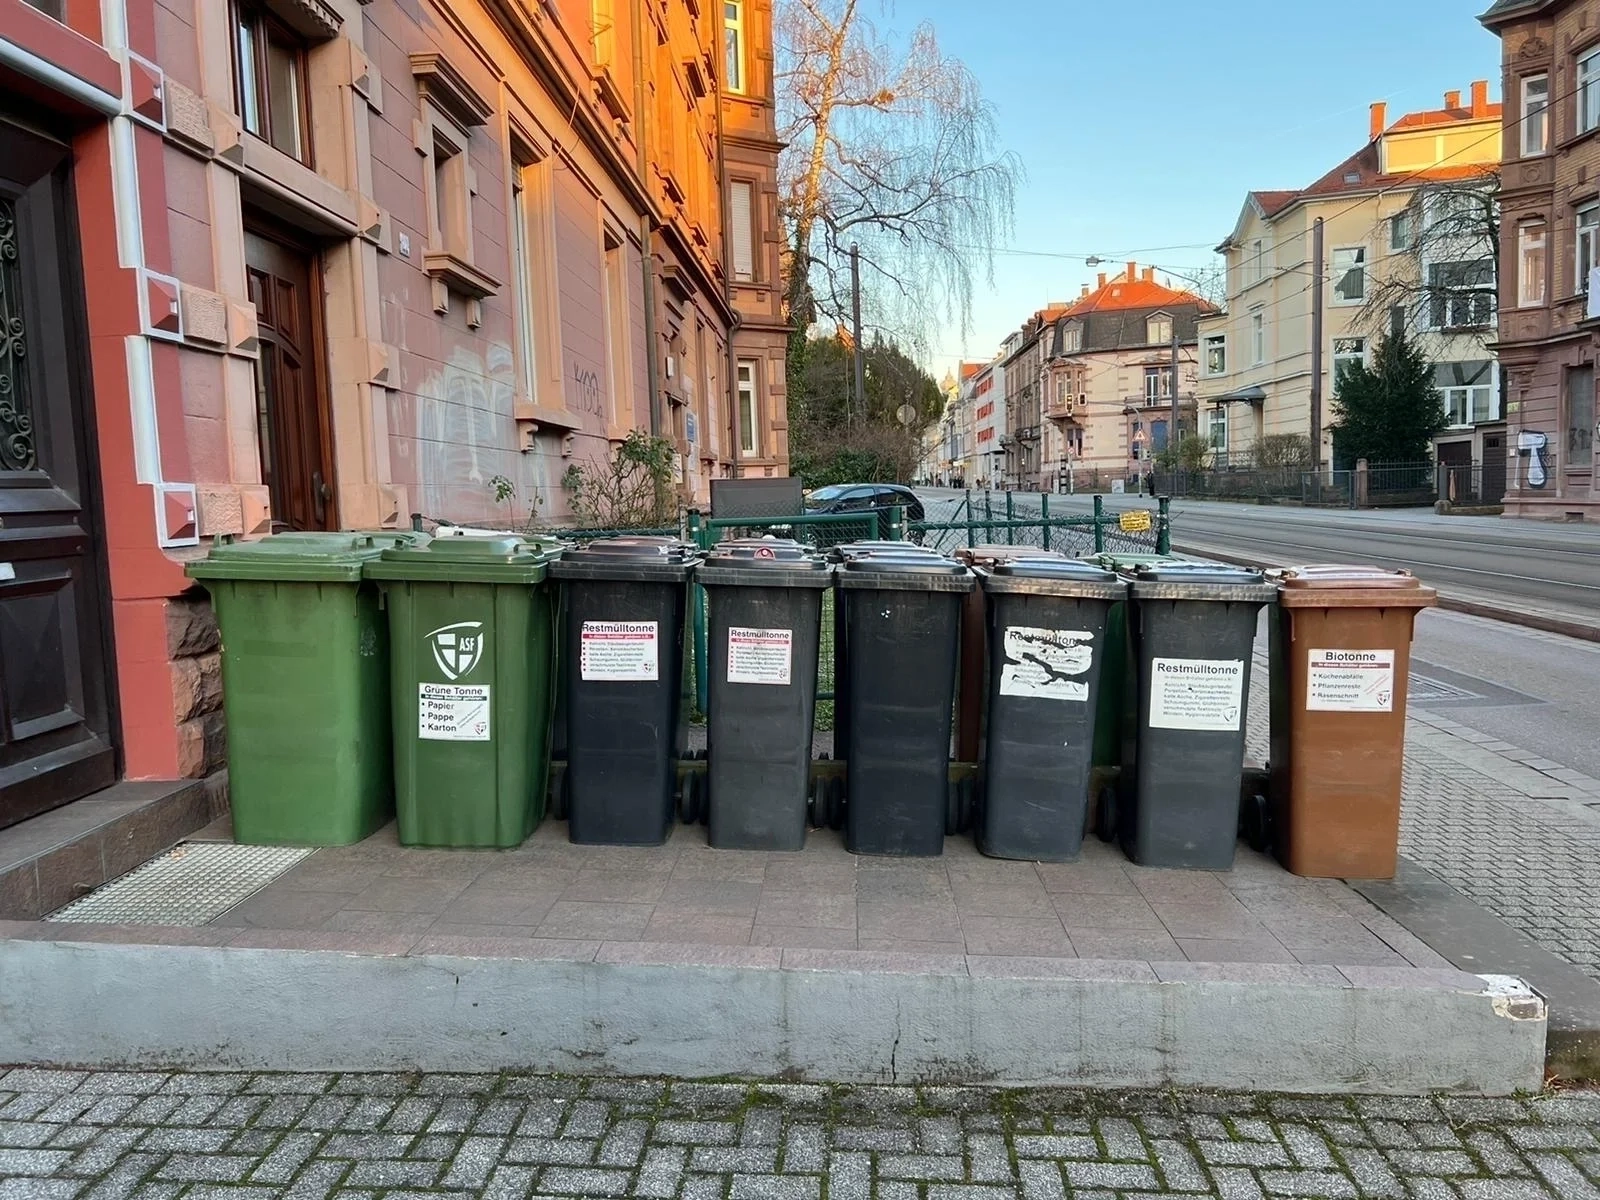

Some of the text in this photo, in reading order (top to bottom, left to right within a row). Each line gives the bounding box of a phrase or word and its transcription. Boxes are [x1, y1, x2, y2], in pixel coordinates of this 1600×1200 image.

[582, 623, 655, 633] Restmülltonne
[731, 629, 790, 639] Restmülltonne
[459, 637, 475, 652] ASF
[1325, 651, 1376, 661] Biotonne
[1157, 662, 1239, 675] Restmülltonne
[424, 685, 483, 696] Grüne Tonne
[427, 700, 455, 711] Papier
[427, 712, 454, 722] Pappe
[427, 722, 457, 733] Karton
